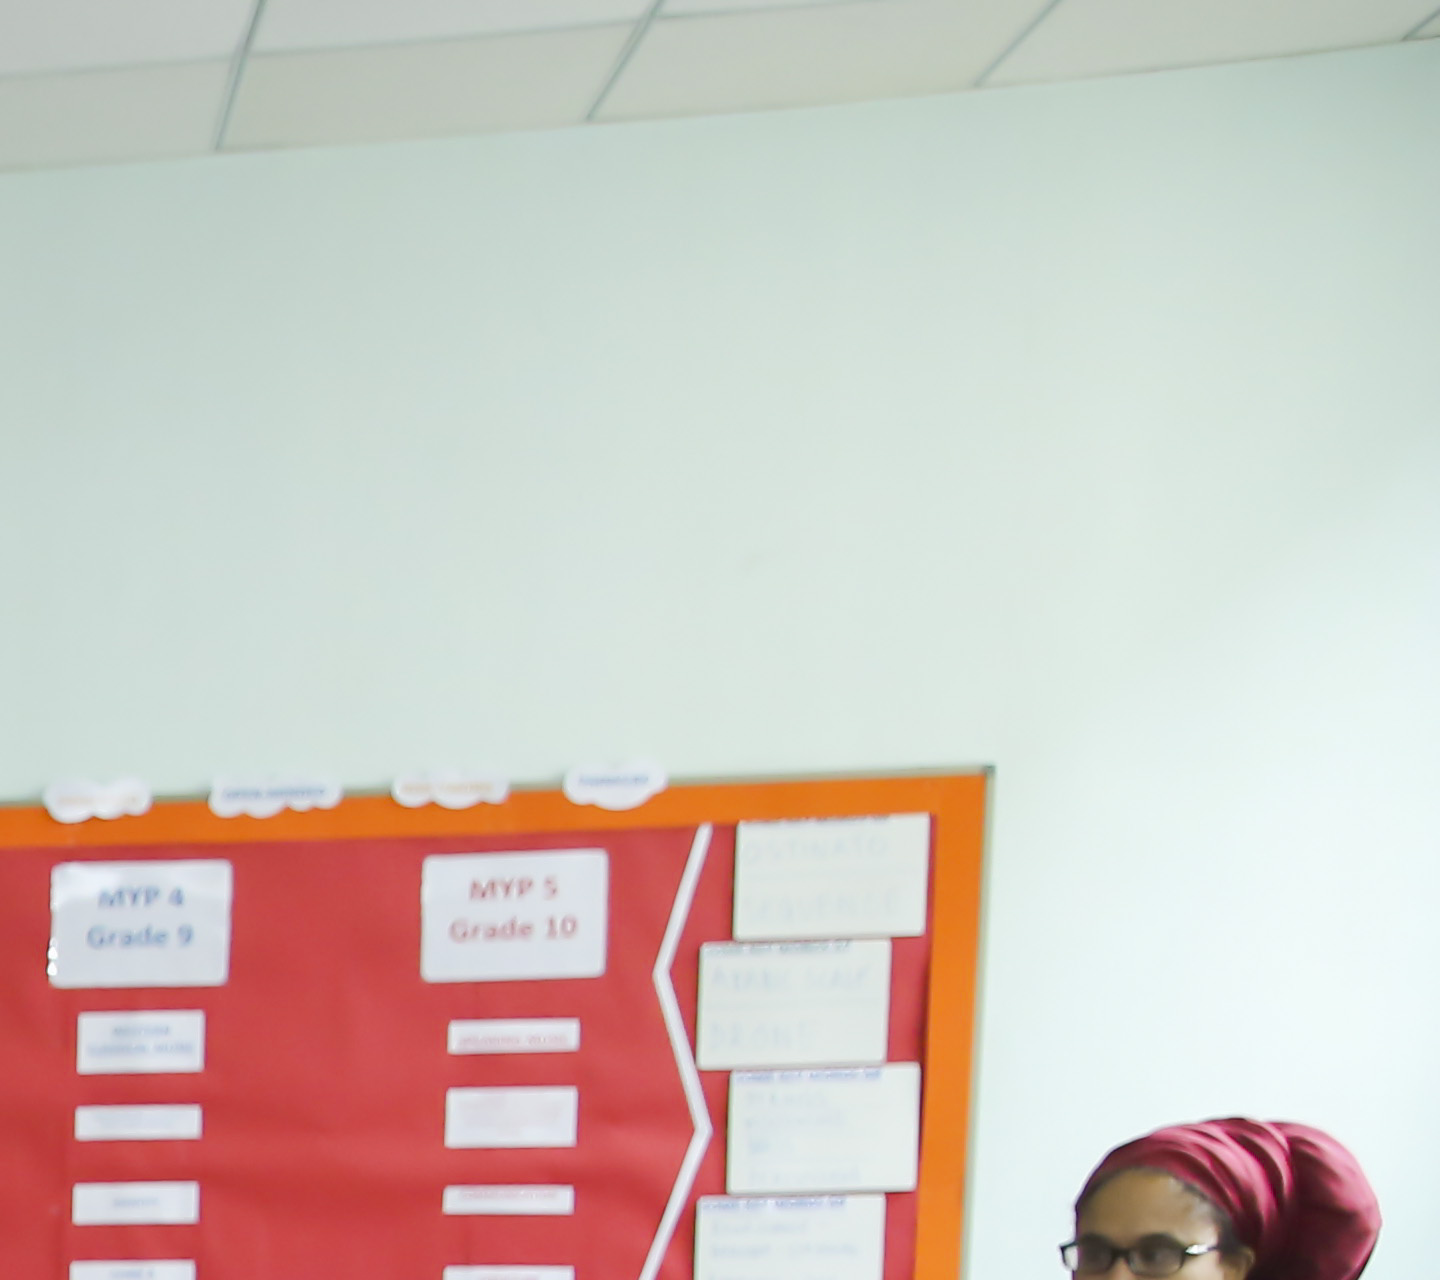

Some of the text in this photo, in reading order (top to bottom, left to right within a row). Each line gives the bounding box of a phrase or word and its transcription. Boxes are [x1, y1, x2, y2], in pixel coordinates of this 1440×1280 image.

[99, 887, 185, 909] MYP 4
[469, 877, 558, 901] MYP 5
[87, 925, 193, 949] Grade 9
[450, 917, 577, 943] Grade 10
